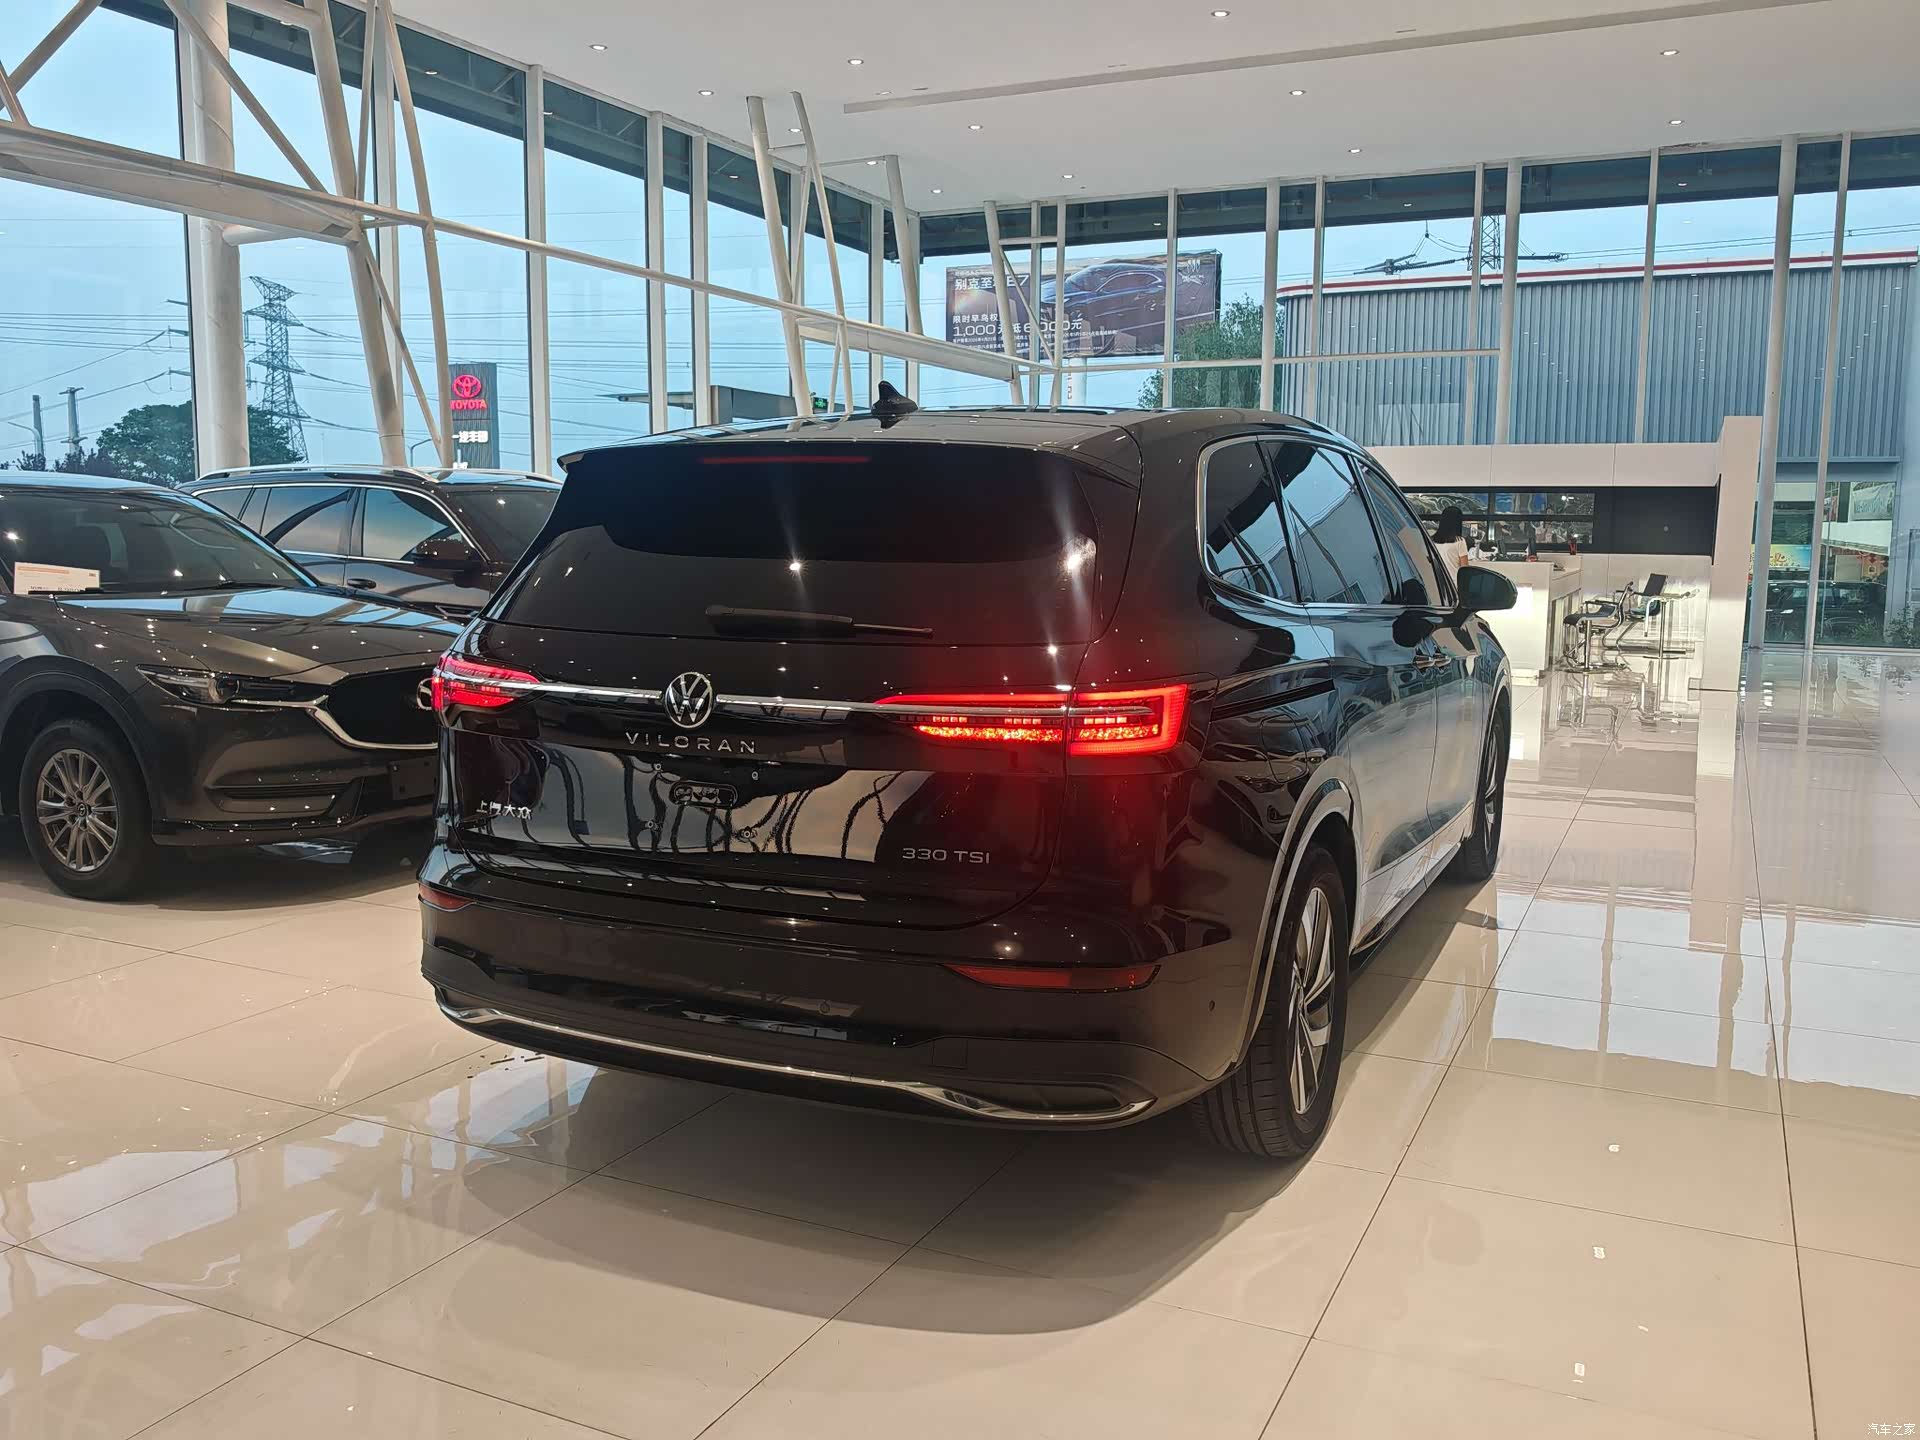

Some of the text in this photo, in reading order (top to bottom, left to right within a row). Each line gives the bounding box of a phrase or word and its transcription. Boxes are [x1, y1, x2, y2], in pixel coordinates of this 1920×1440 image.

[450, 399, 487, 410] TOYOTA
[625, 732, 755, 754] VILORAN
[476, 800, 532, 820] 上汽大众
[902, 848, 990, 864] 330 TSI
